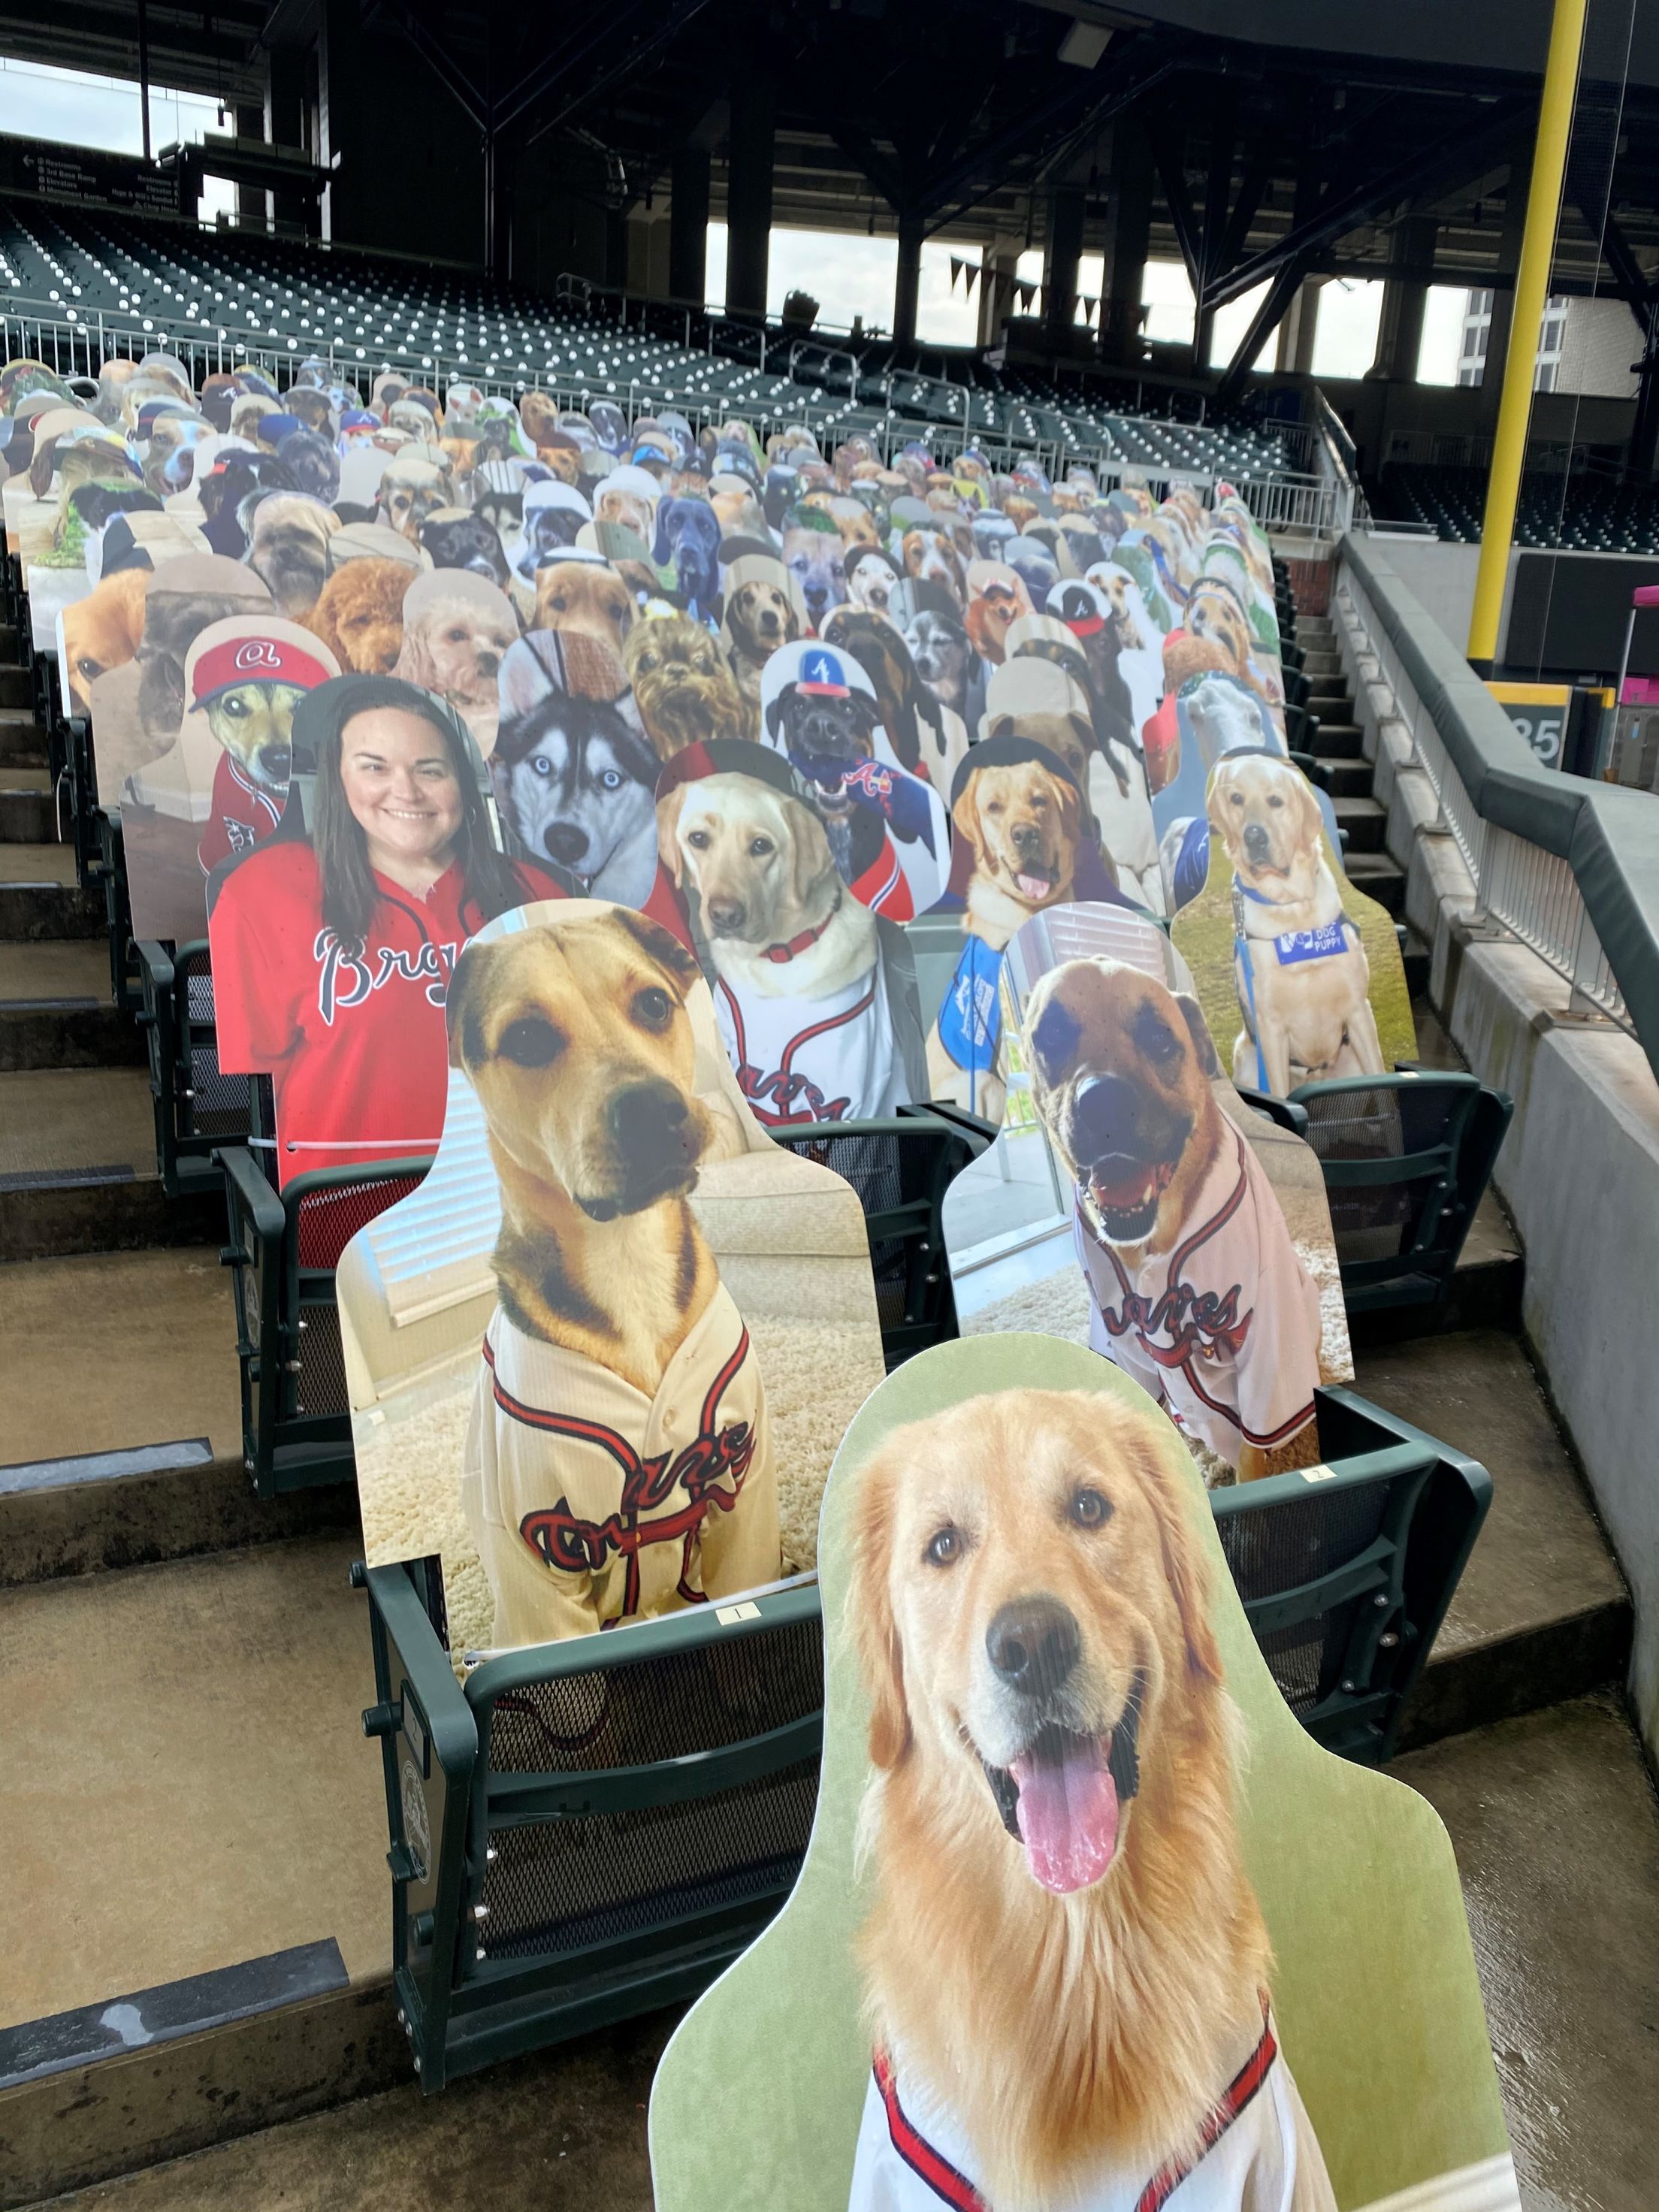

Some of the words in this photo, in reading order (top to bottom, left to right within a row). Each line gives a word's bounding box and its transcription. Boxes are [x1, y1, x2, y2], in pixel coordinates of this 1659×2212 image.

[45, 158, 81, 171] Restrooms
[46, 168, 57, 177] 3rd
[59, 170, 76, 180] Base
[77, 173, 97, 184] Ramp
[1316, 926, 1336, 941] DOG
[1314, 935, 1341, 952] PUPPY
